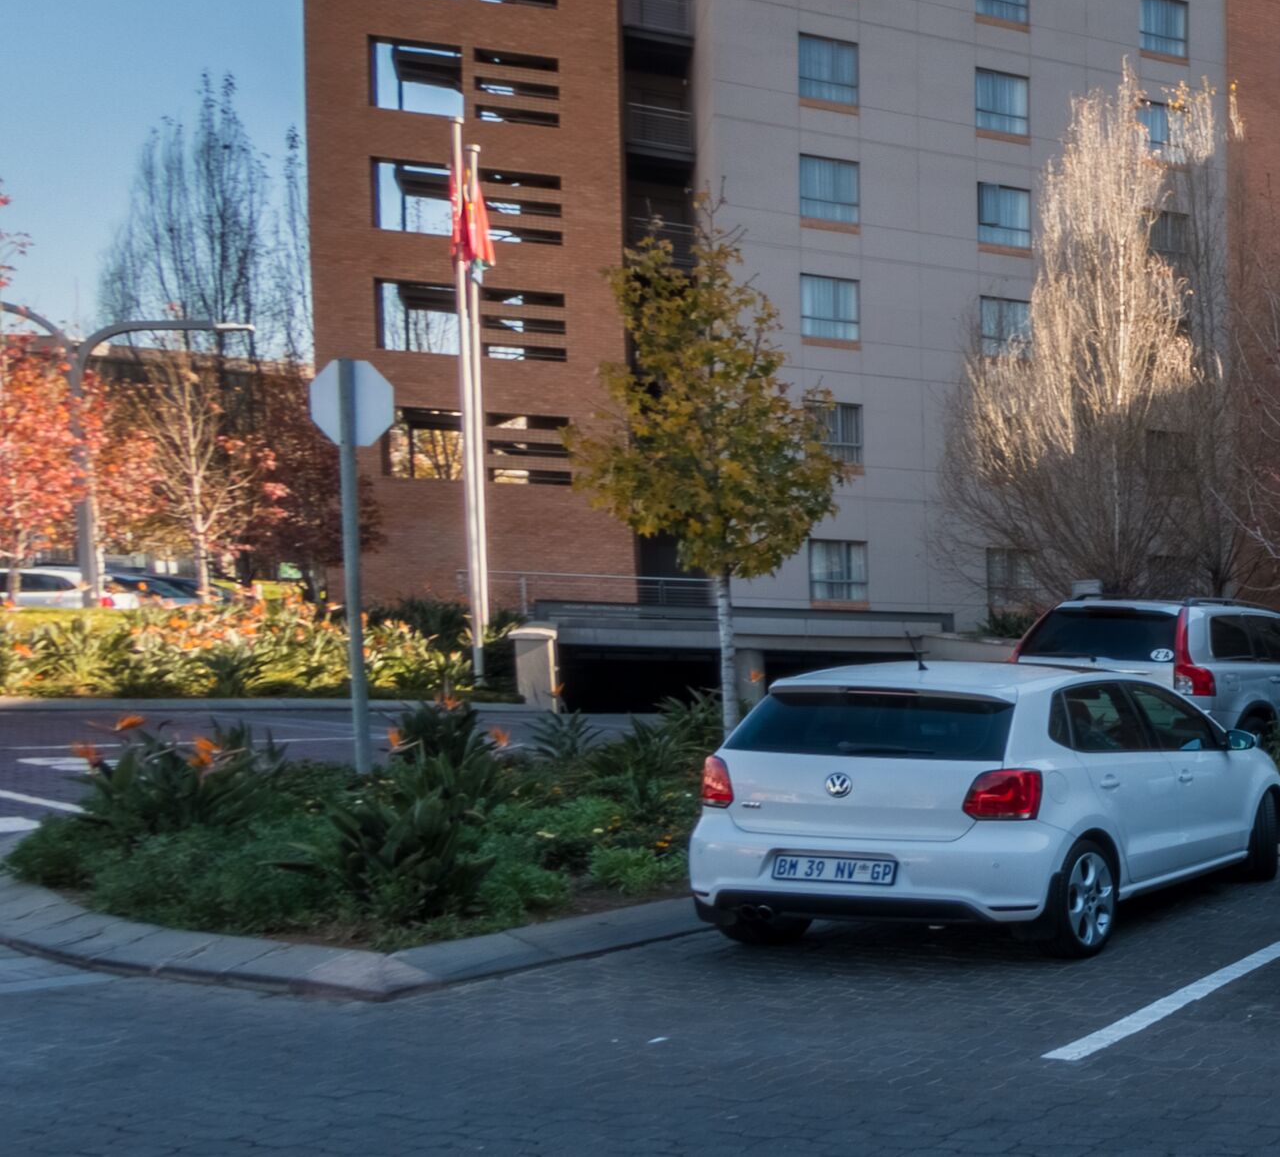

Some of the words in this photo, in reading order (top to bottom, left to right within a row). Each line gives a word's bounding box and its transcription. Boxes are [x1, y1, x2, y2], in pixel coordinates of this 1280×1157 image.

[776, 858, 799, 876] BM
[804, 860, 825, 878] 39
[834, 861, 857, 879] NV
[870, 863, 892, 881] GP
